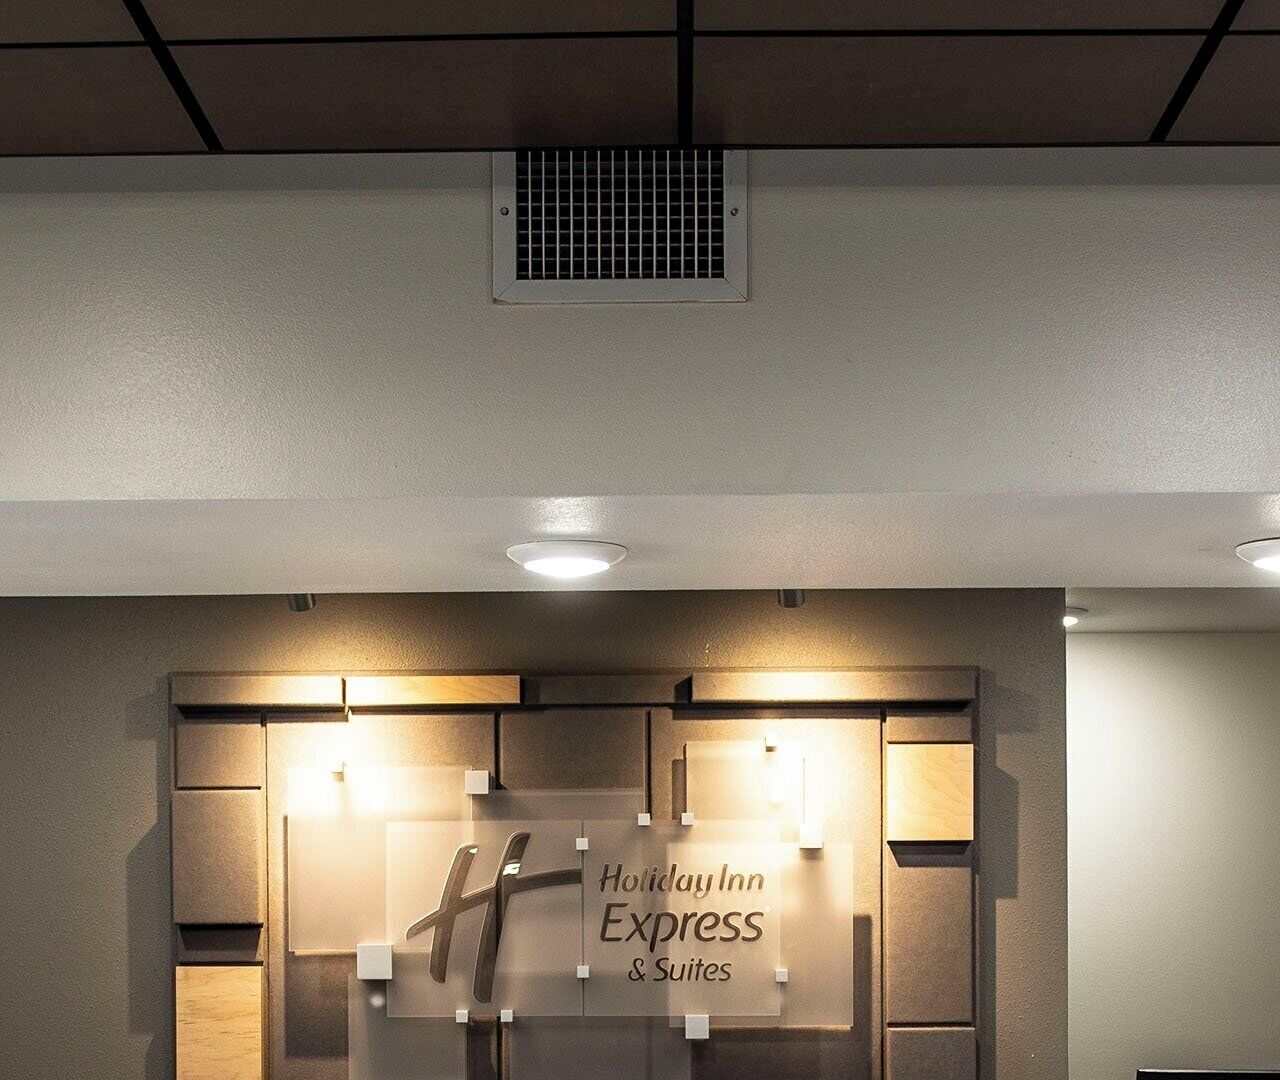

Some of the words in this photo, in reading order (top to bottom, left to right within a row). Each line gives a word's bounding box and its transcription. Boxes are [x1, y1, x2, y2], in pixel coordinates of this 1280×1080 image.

[599, 864, 713, 899] Holiday
[719, 863, 764, 891] Inn
[600, 902, 764, 953] Express
[628, 957, 646, 982] &
[653, 957, 732, 982] Suites
